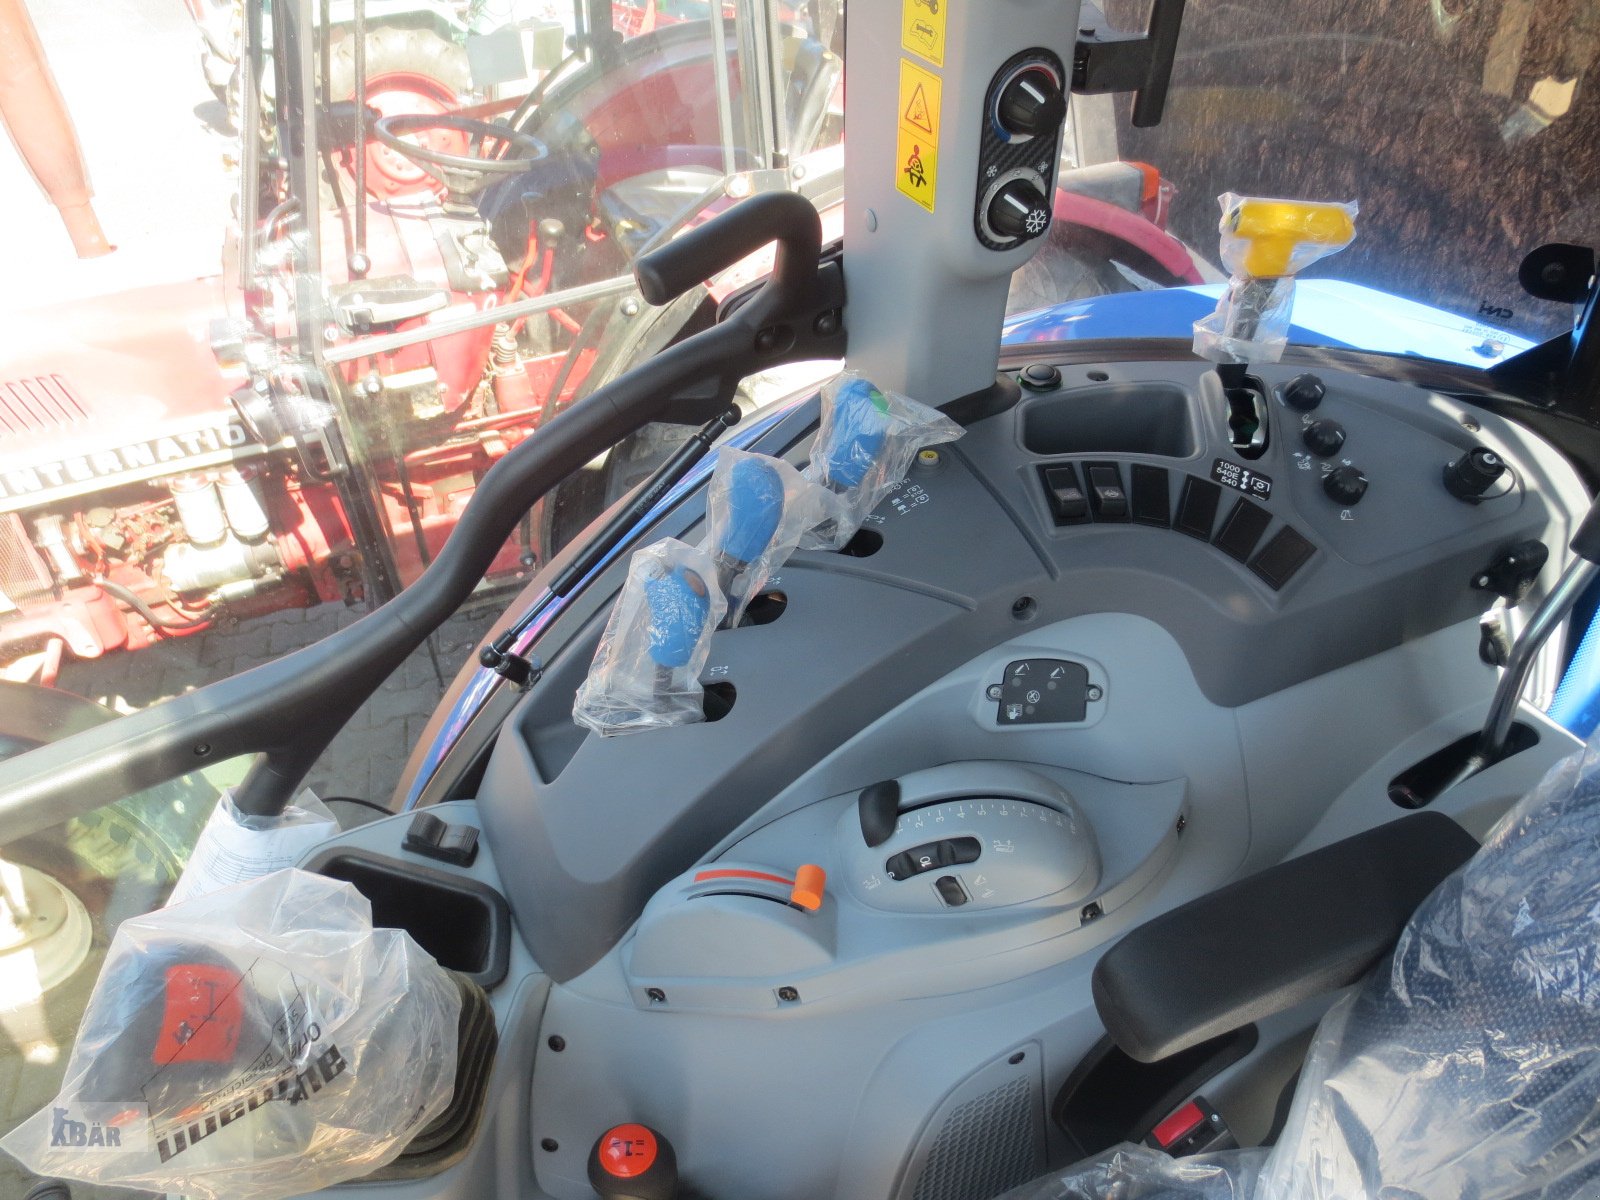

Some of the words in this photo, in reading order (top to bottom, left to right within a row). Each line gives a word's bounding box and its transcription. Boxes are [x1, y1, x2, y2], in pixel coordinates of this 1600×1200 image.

[1219, 460, 1241, 473] 1000
[1216, 467, 1239, 480] 540E
[1220, 475, 1238, 487] 540
[919, 856, 932, 868] 10
